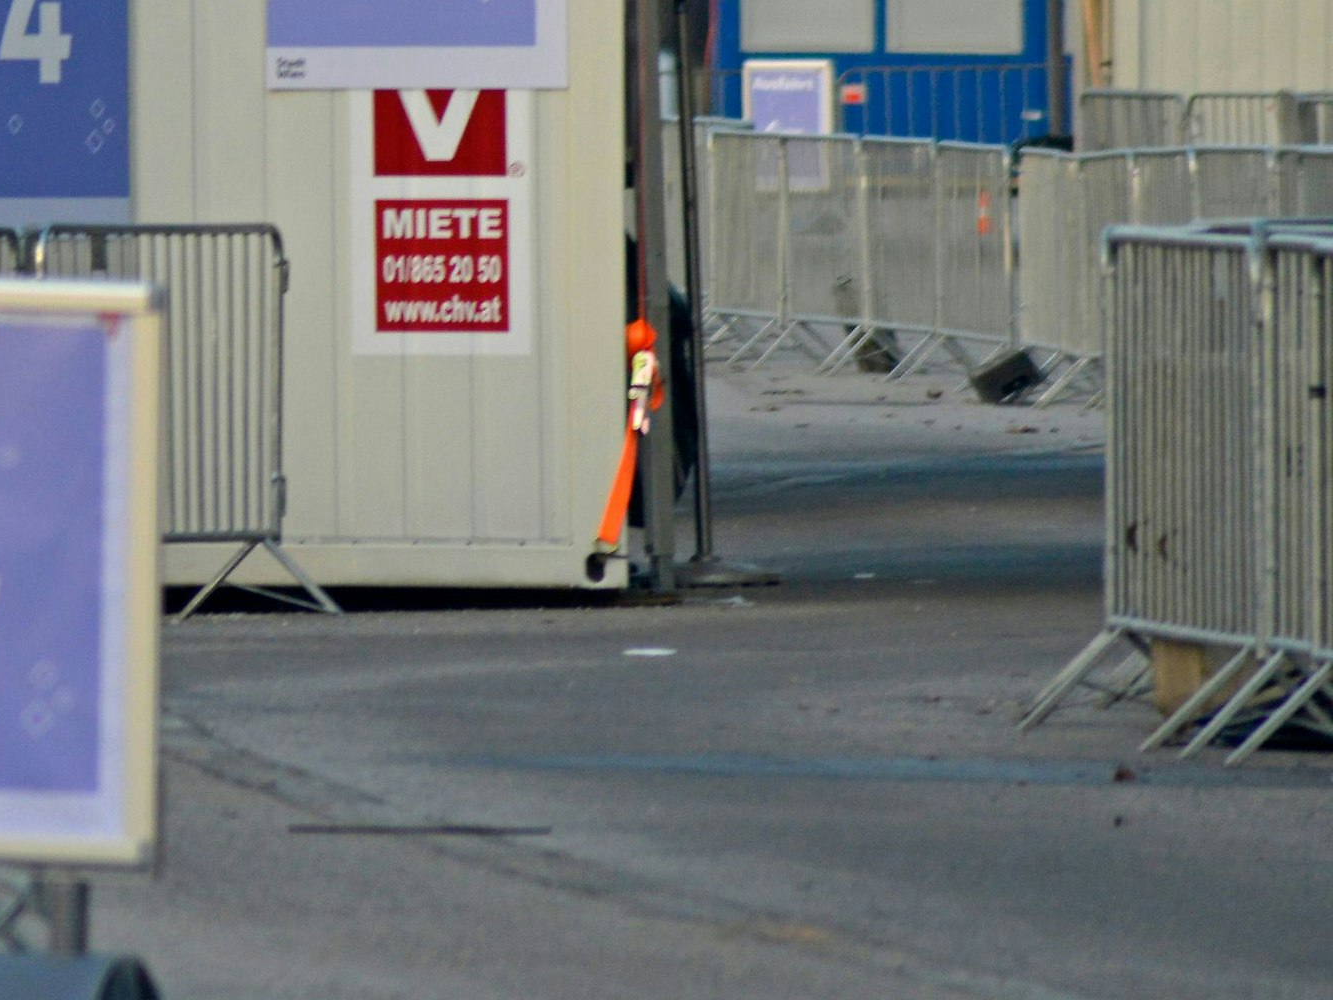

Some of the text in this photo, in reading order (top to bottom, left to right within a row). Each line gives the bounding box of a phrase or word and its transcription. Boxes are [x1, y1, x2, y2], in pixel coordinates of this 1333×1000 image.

[398, 89, 481, 161] V
[383, 208, 503, 240] MIETE
[383, 255, 502, 284] 01/865 20 50
[384, 295, 502, 323] www.chv.at
